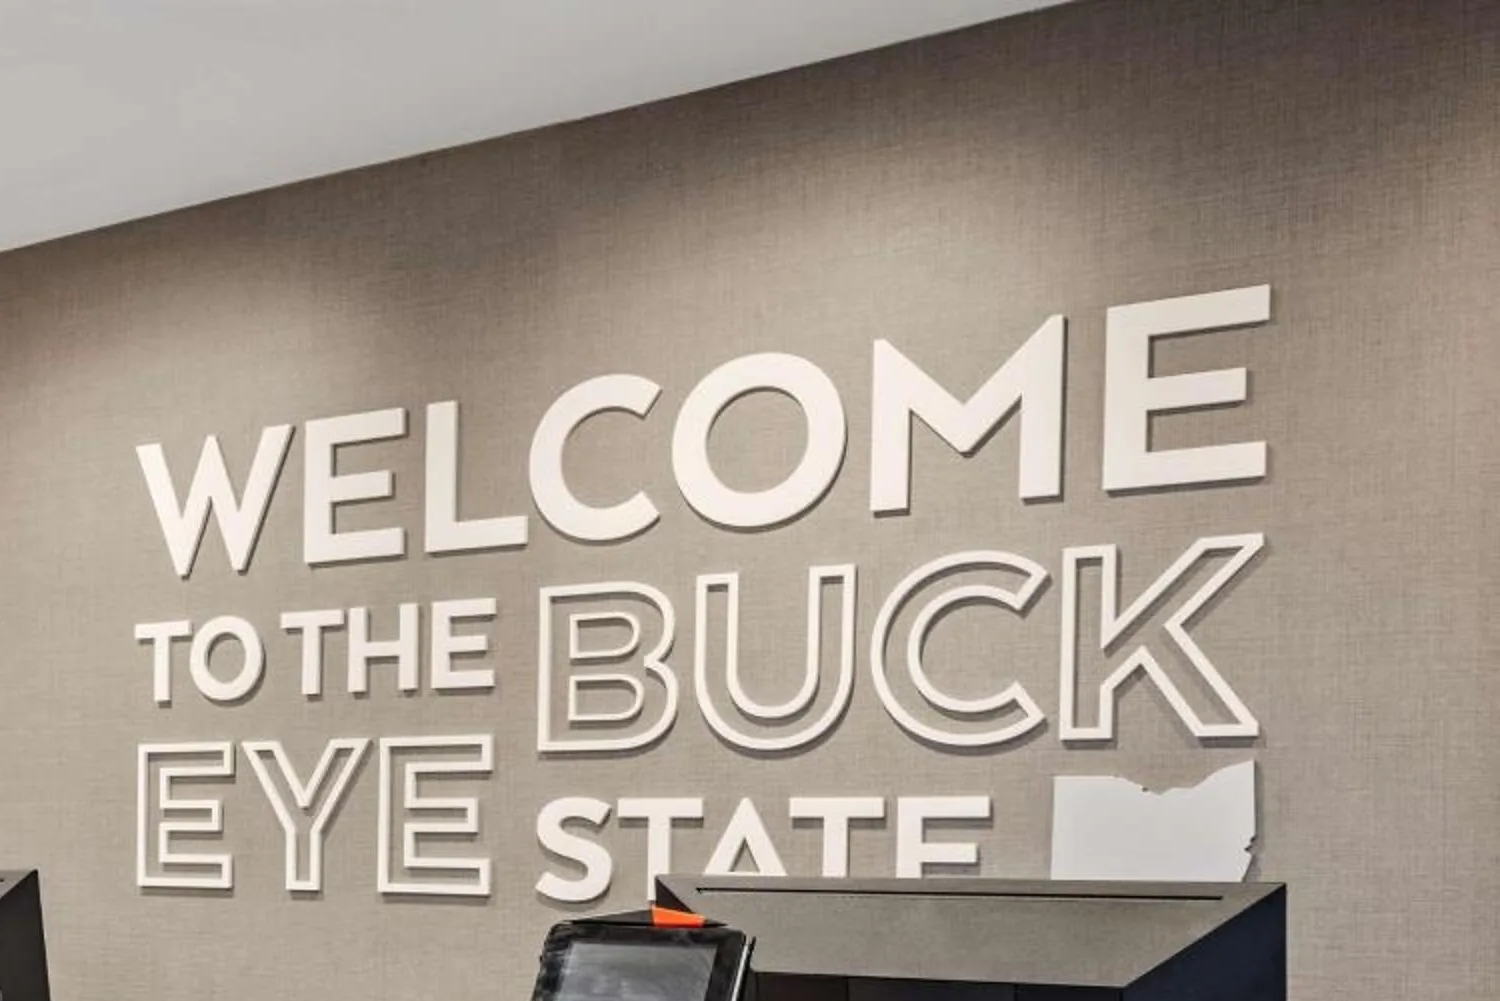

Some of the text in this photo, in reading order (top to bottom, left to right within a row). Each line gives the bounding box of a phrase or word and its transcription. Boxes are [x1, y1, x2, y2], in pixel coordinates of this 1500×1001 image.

[134, 284, 1272, 579] WELCOME
[134, 532, 1267, 755] TO THE BUCK
[135, 732, 992, 904] EYE STATE
